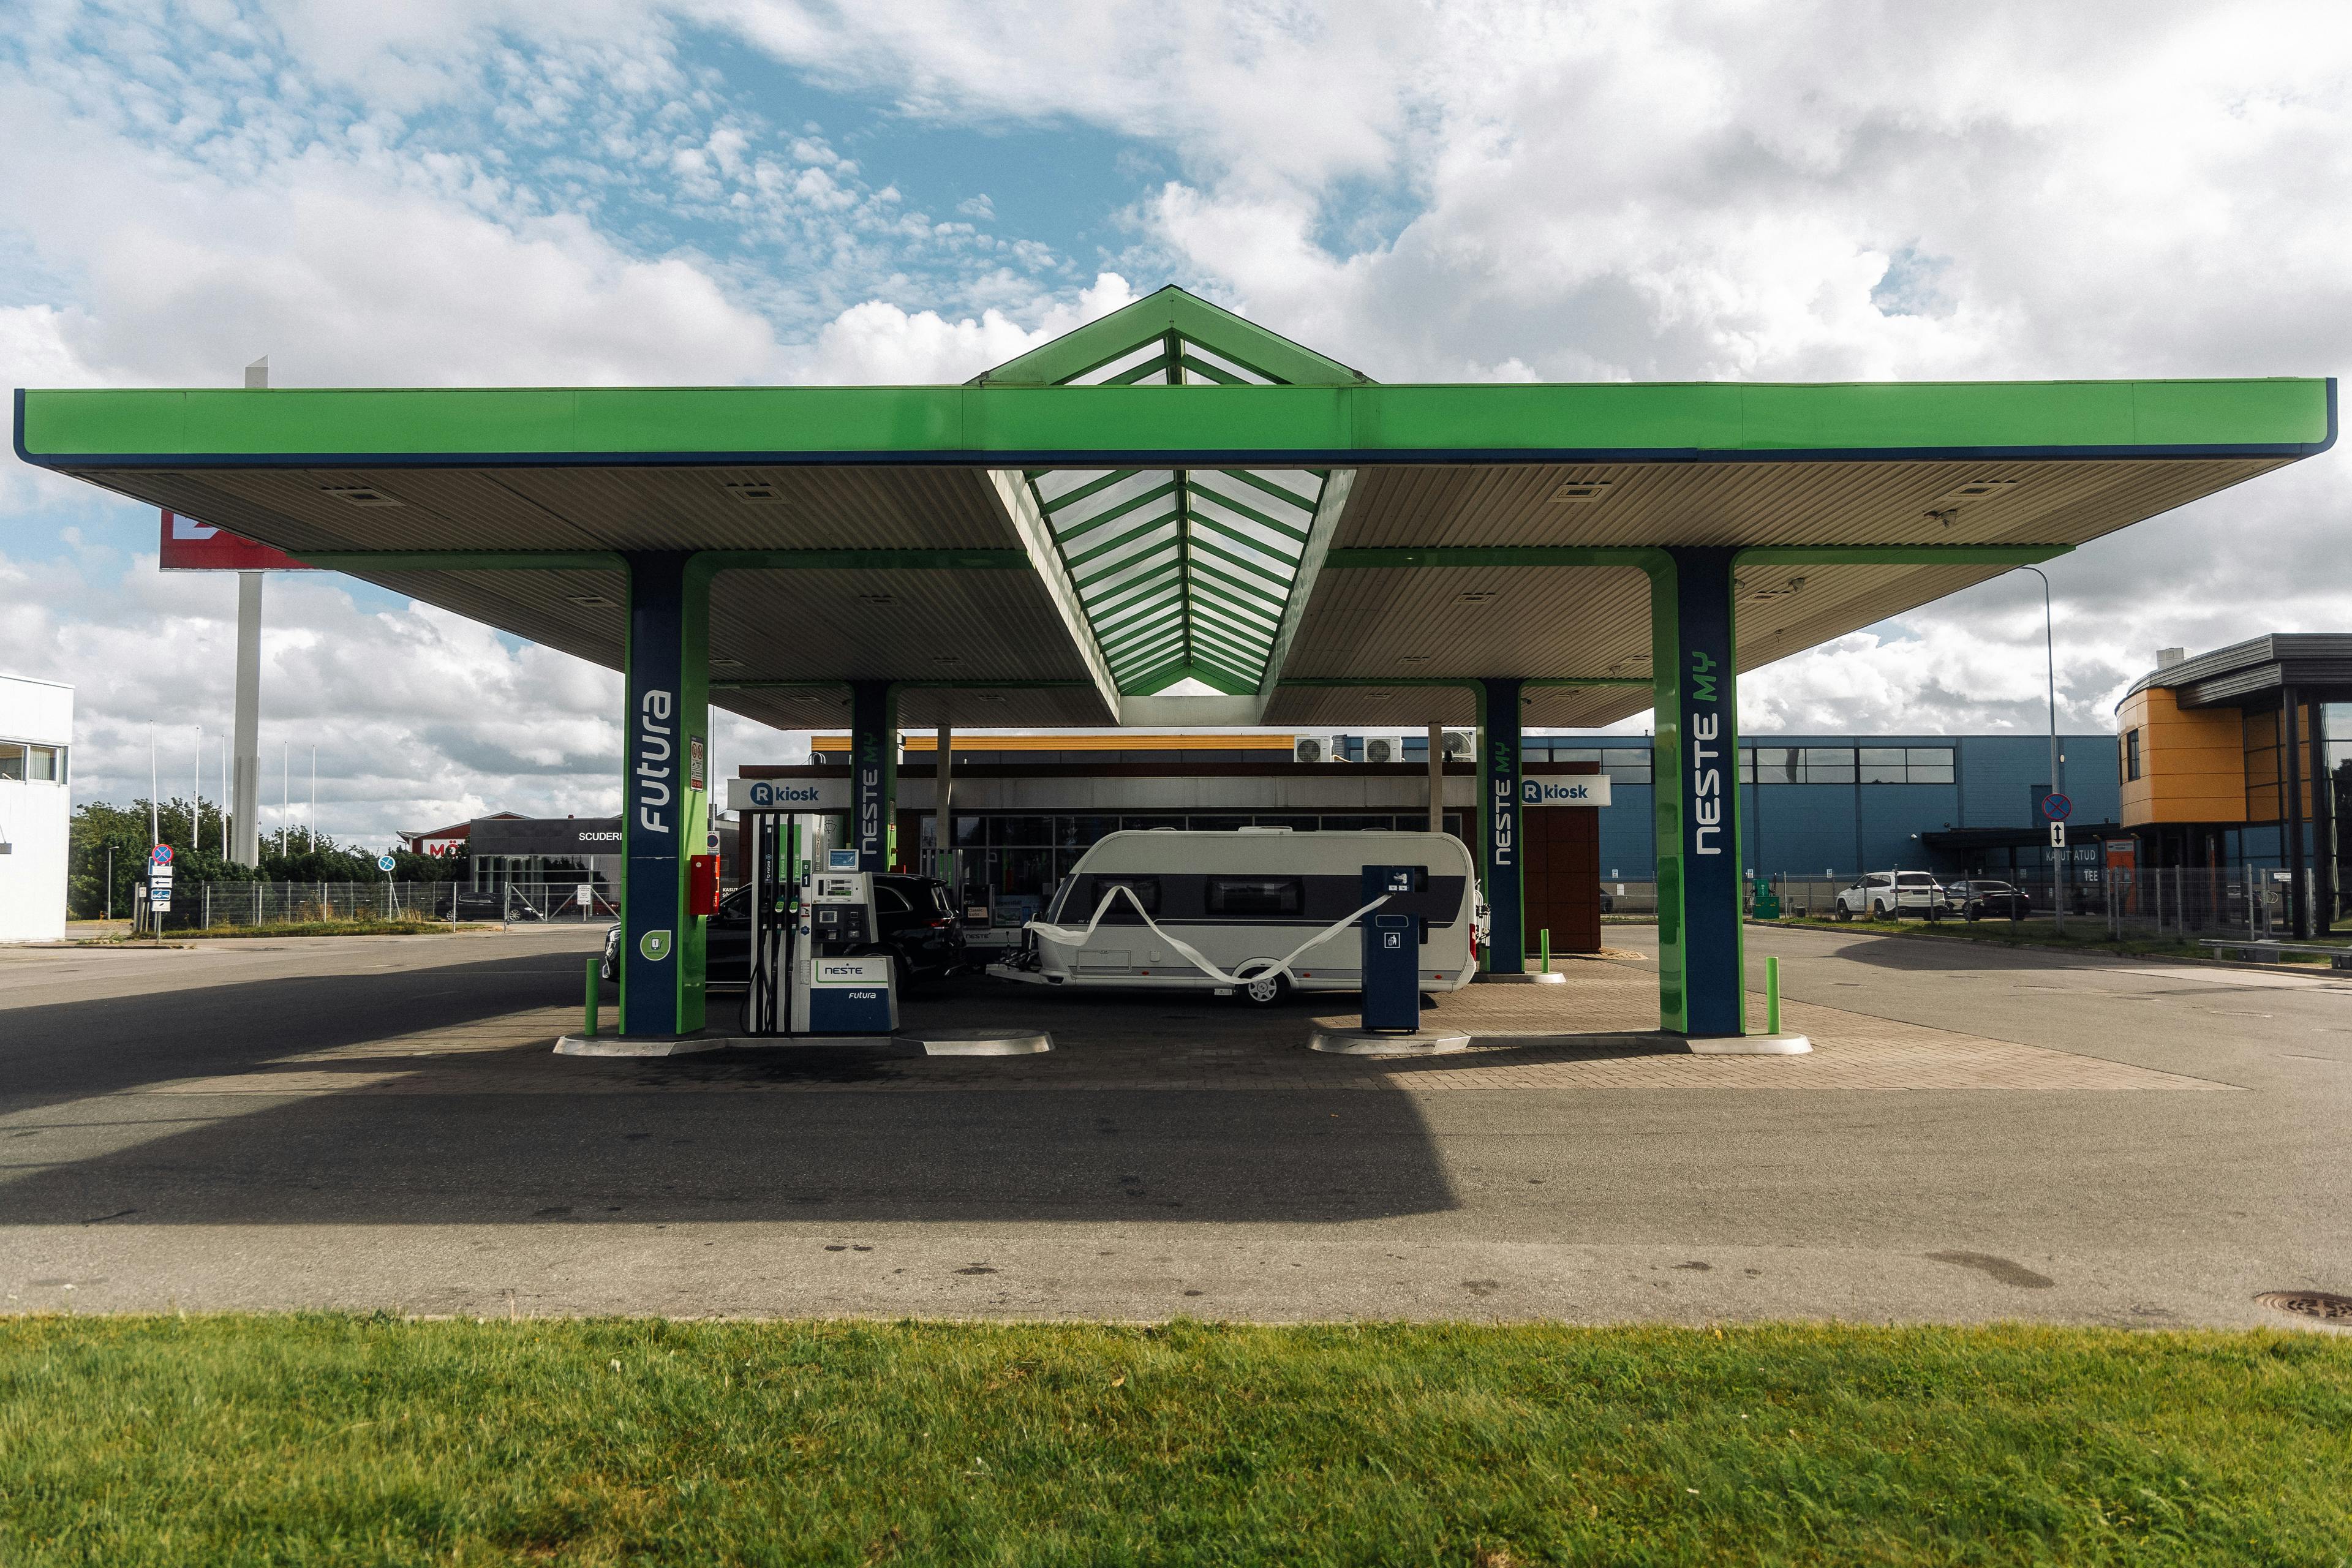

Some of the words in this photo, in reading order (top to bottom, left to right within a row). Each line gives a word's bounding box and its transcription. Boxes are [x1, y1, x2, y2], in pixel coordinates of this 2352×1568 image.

[1692, 651, 1717, 701] MY
[637, 690, 671, 833] Futura
[862, 733, 878, 763] MY
[1495, 742, 1510, 773] MY
[775, 786, 819, 801] kiosk
[1544, 784, 1588, 799] kiosk
[1694, 713, 1721, 854] NESTE
[862, 769, 878, 854] NESTE
[1495, 779, 1511, 865] NESTE
[2046, 849, 2096, 861] KAUTATUD
[804, 876, 808, 885] 1
